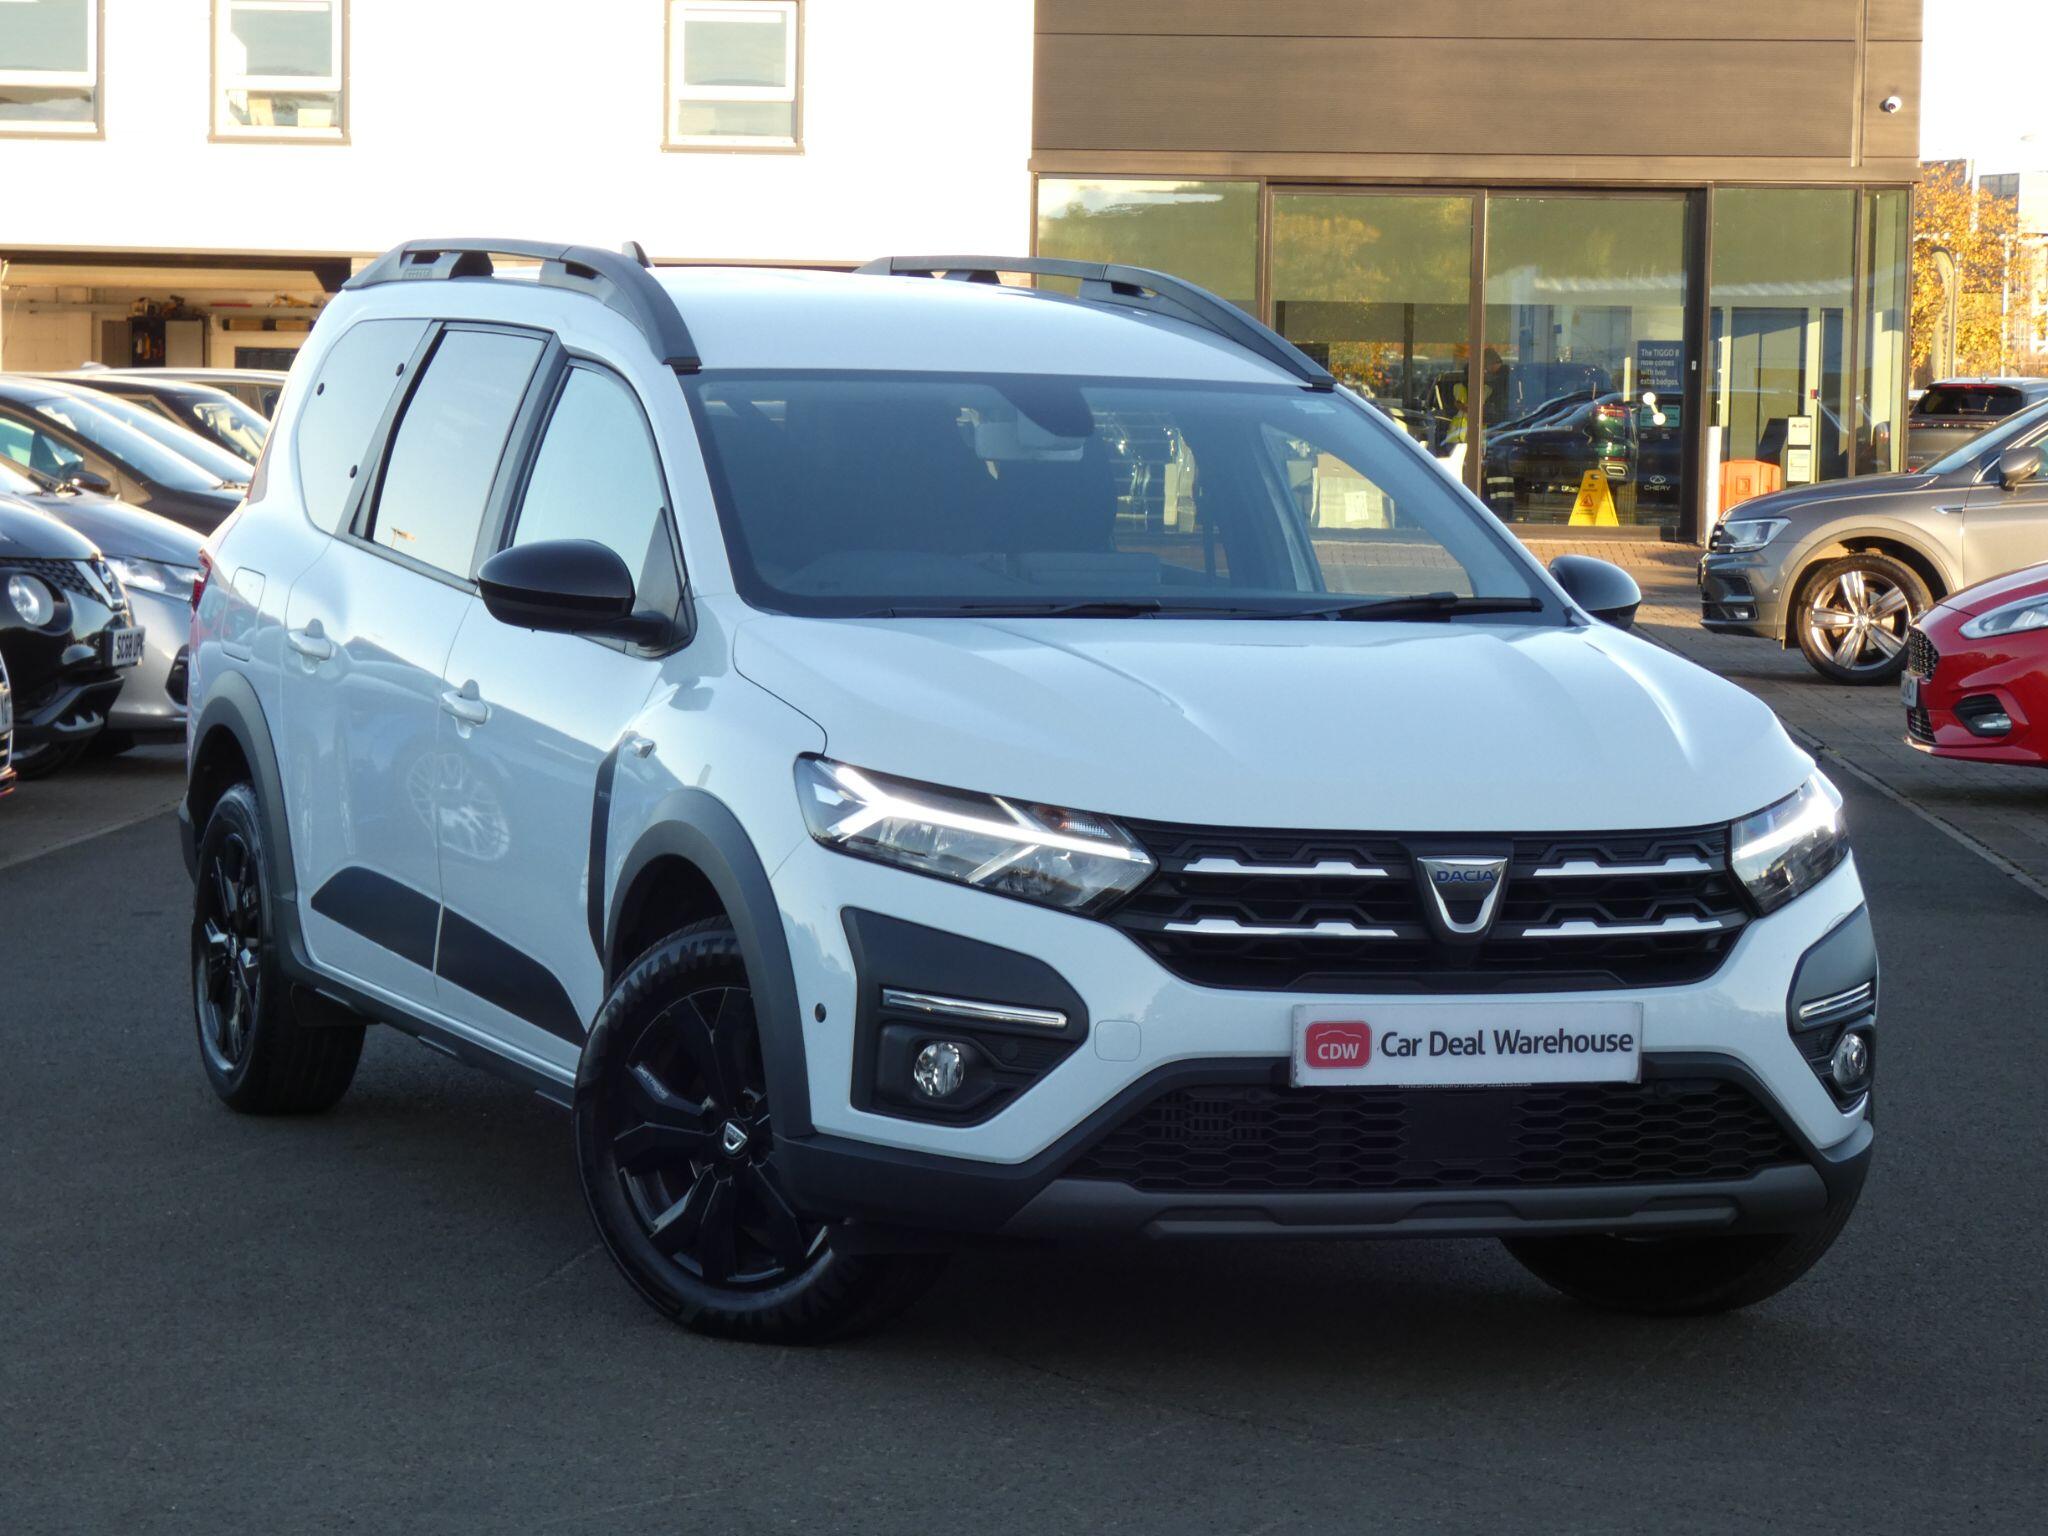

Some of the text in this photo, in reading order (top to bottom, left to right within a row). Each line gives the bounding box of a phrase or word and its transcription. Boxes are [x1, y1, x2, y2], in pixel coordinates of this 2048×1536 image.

[1641, 349, 1652, 357] The
[1654, 349, 1674, 357] TIGGO
[1644, 484, 1671, 492] CHERY
[1436, 870, 1494, 882] DACIA
[1380, 1028, 1634, 1057] Car Deal Warehouse
[1317, 1043, 1359, 1060] CDW
